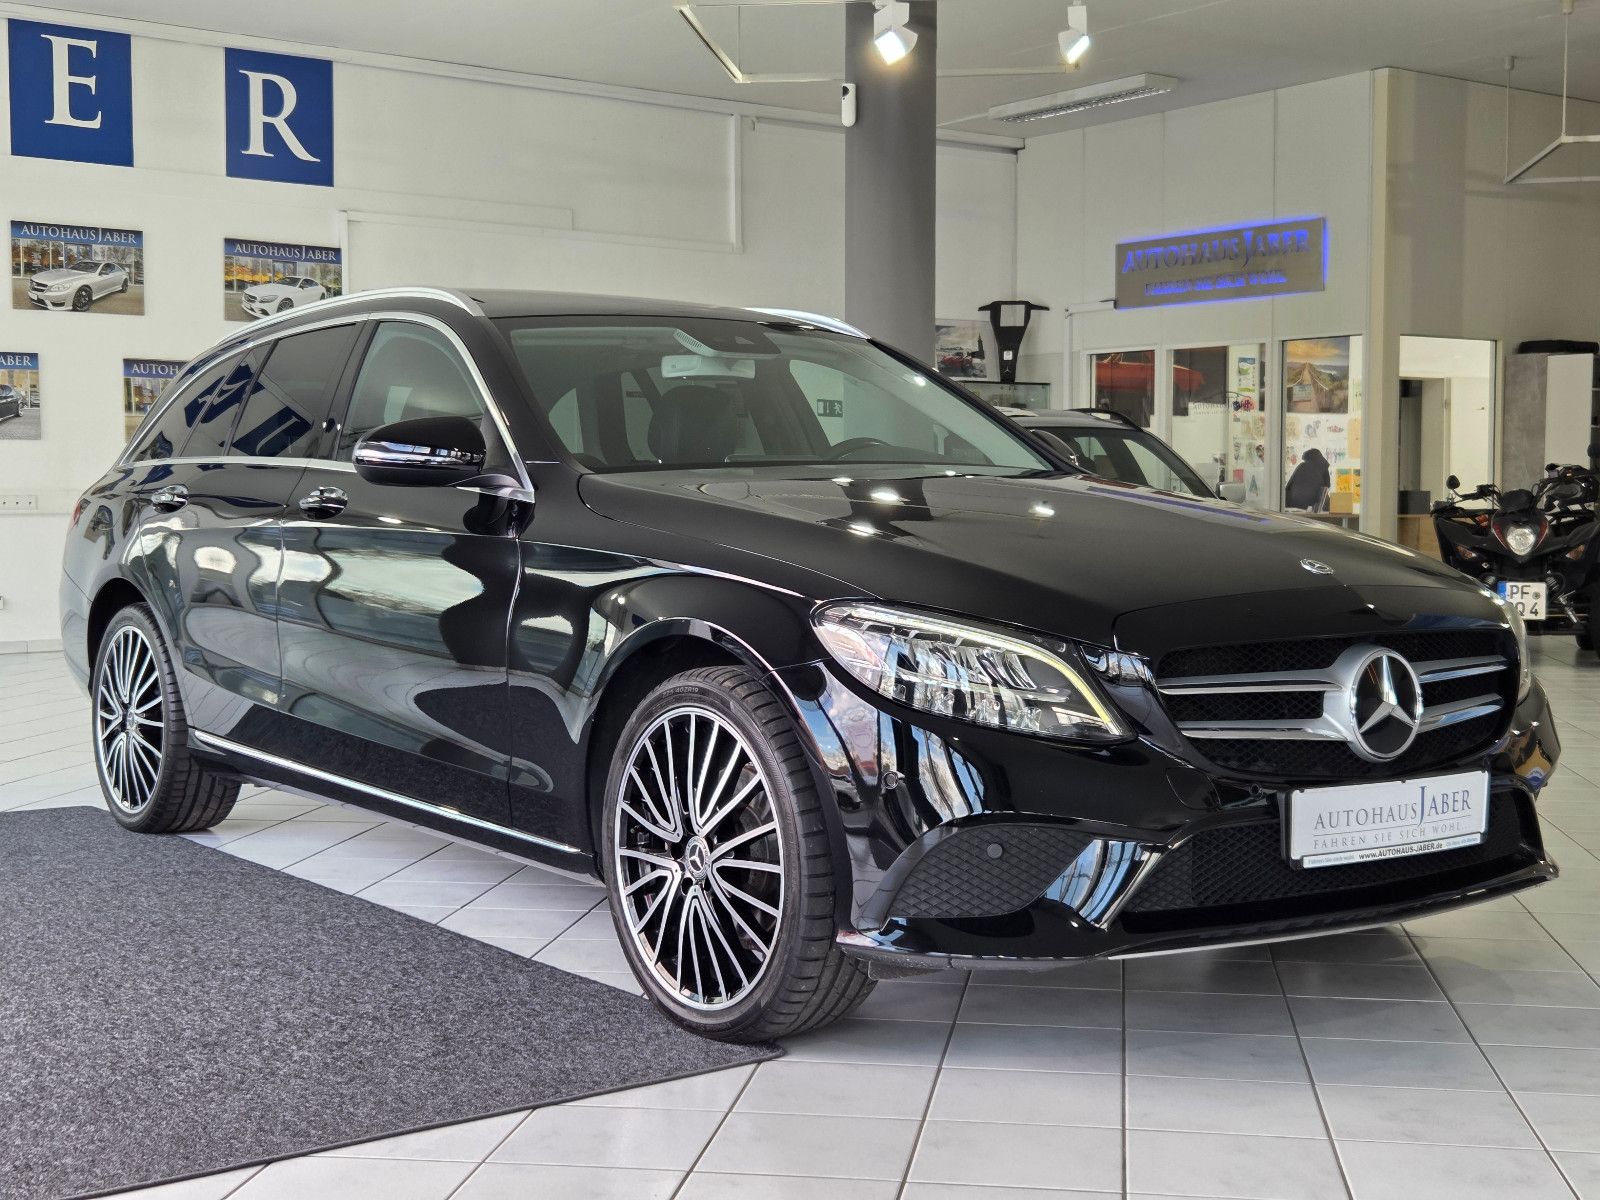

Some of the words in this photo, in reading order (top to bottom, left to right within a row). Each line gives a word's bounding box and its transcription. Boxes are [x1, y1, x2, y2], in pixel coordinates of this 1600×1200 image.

[40, 34, 102, 129] E
[238, 69, 321, 162] R
[1509, 584, 1531, 600] PF
[1529, 602, 1539, 617] 4
[1313, 834, 1367, 850] FAHREN
[1374, 831, 1393, 845] SIE
[1399, 827, 1426, 840] SICH
[1358, 842, 1443, 860] www.AUTOHAUS-JABER.de
